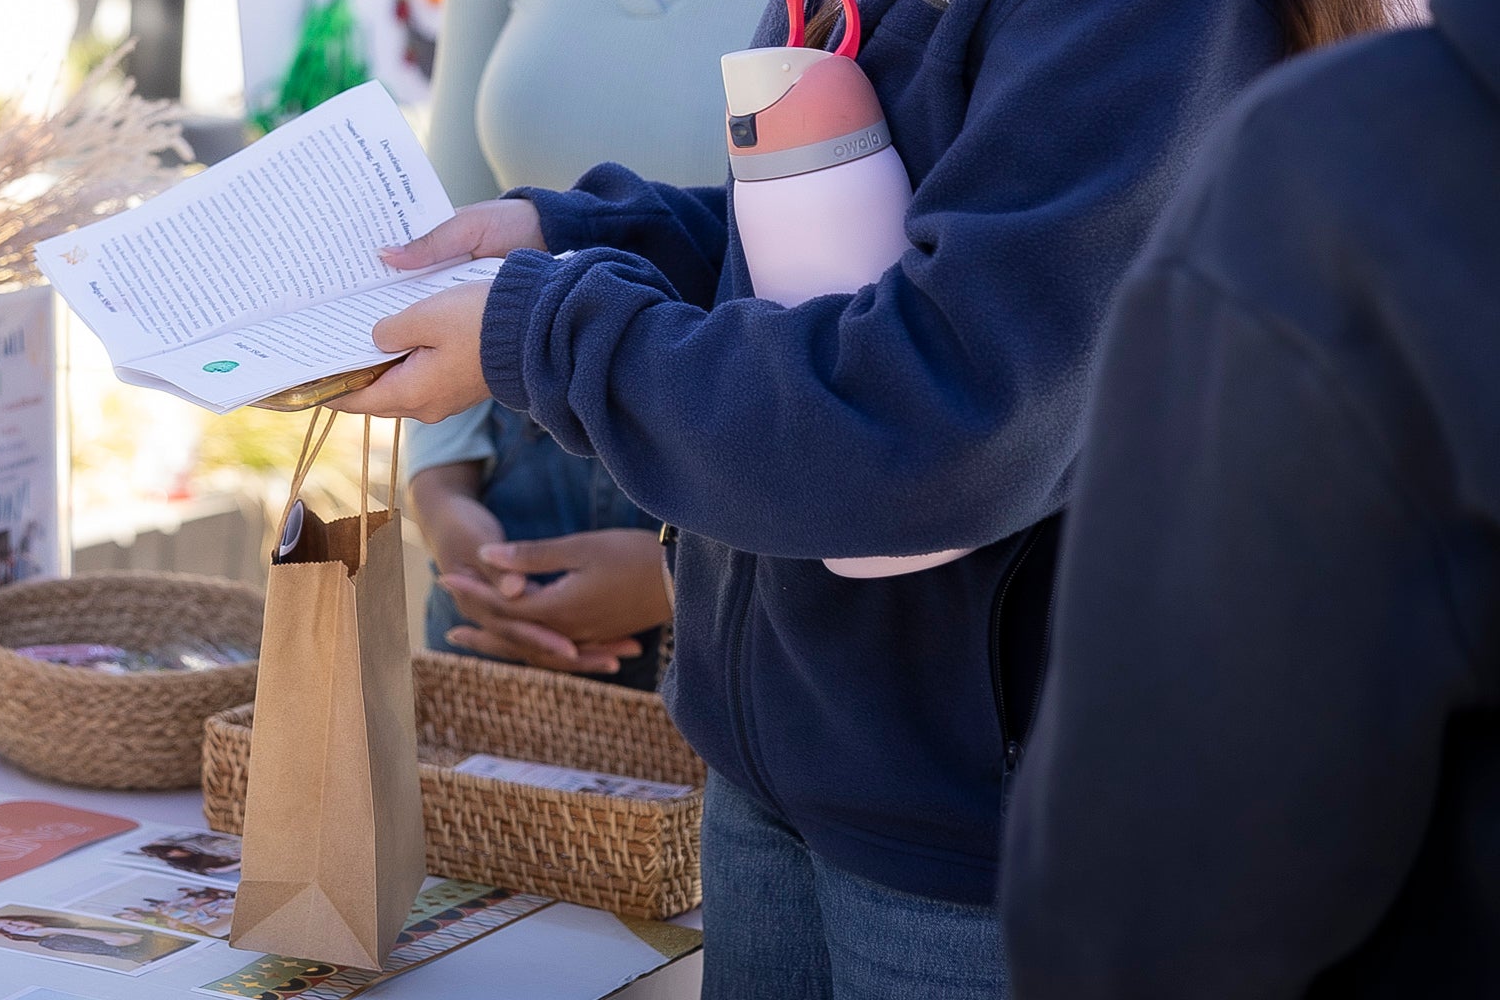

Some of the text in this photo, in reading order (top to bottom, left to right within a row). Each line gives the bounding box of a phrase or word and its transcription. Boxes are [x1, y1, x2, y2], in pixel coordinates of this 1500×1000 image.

[834, 131, 882, 158] owala
[372, 161, 396, 199] Pickleball,
[381, 138, 416, 203] Devotion Fitness
